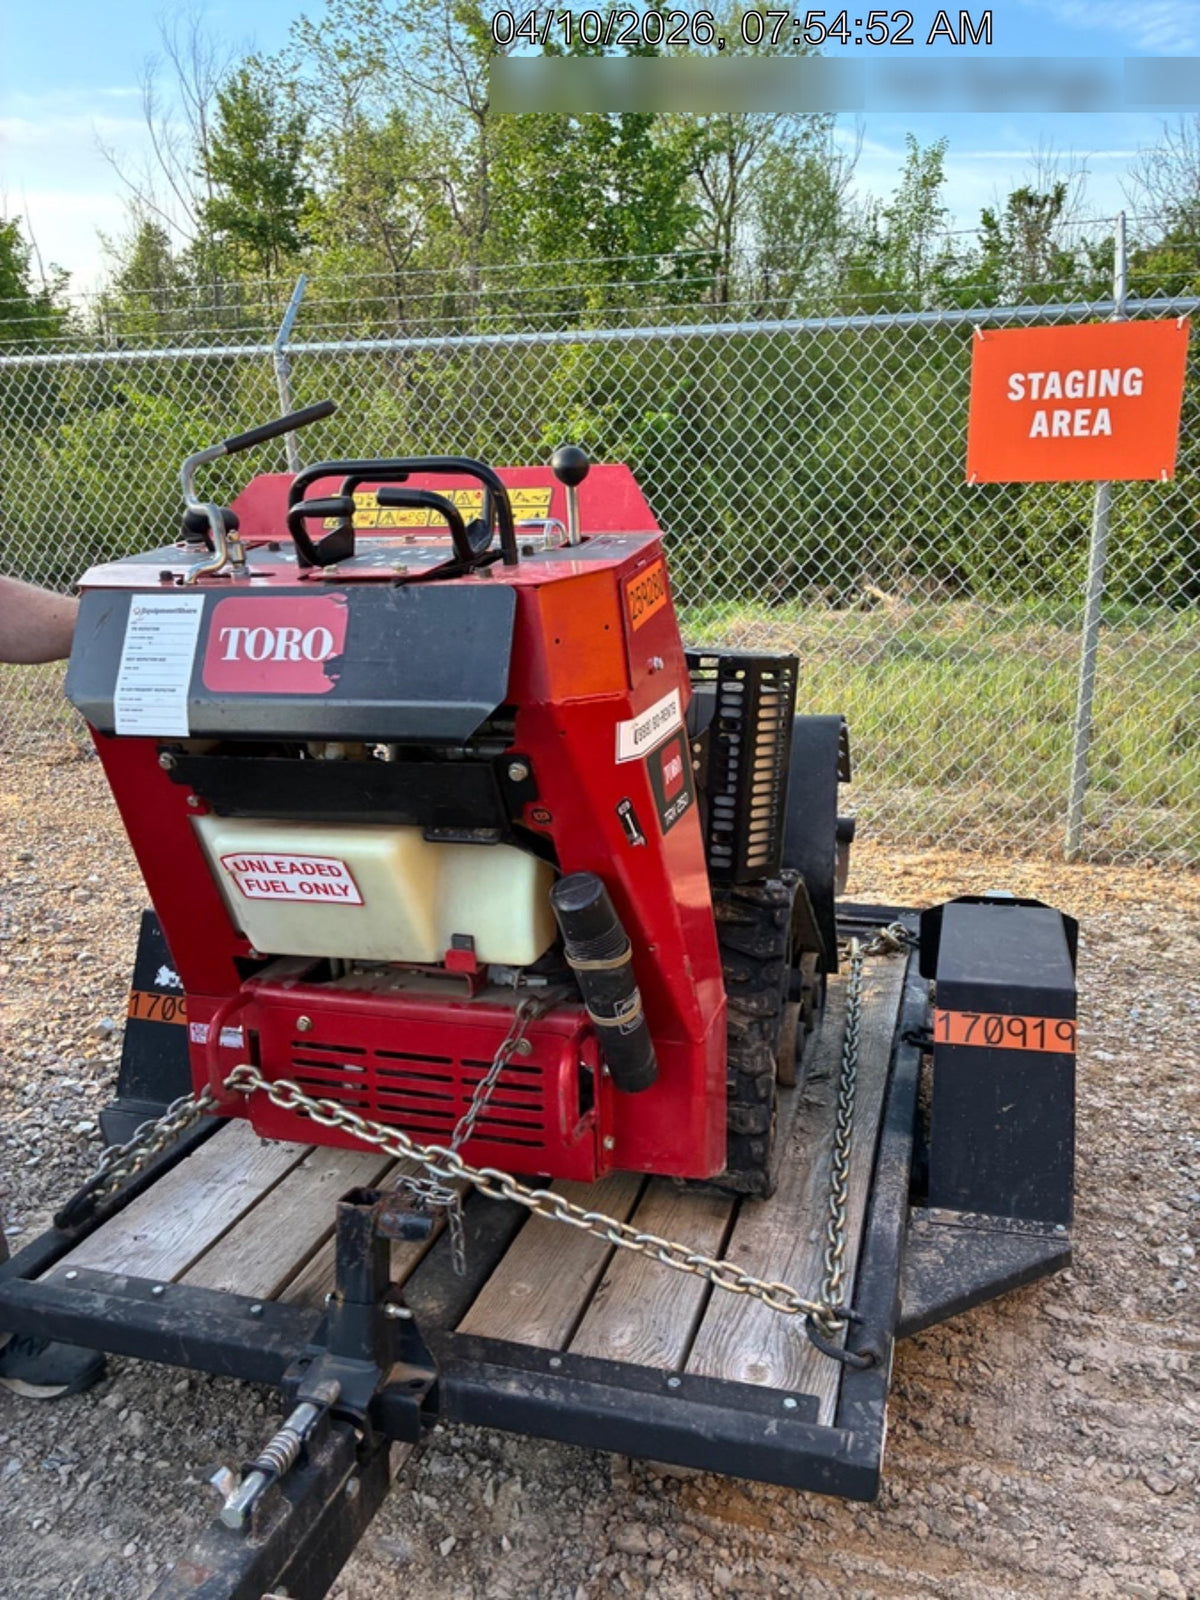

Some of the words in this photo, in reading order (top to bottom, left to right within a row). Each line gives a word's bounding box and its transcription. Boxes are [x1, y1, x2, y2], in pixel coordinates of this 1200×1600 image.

[1007, 367, 1144, 402] STAGING
[1028, 408, 1112, 439] AREA
[218, 626, 334, 663] TORO
[232, 860, 342, 877] UNLEADED
[244, 878, 296, 894] FUEL
[298, 881, 350, 897] ONLY
[937, 1012, 1076, 1051] 170919
